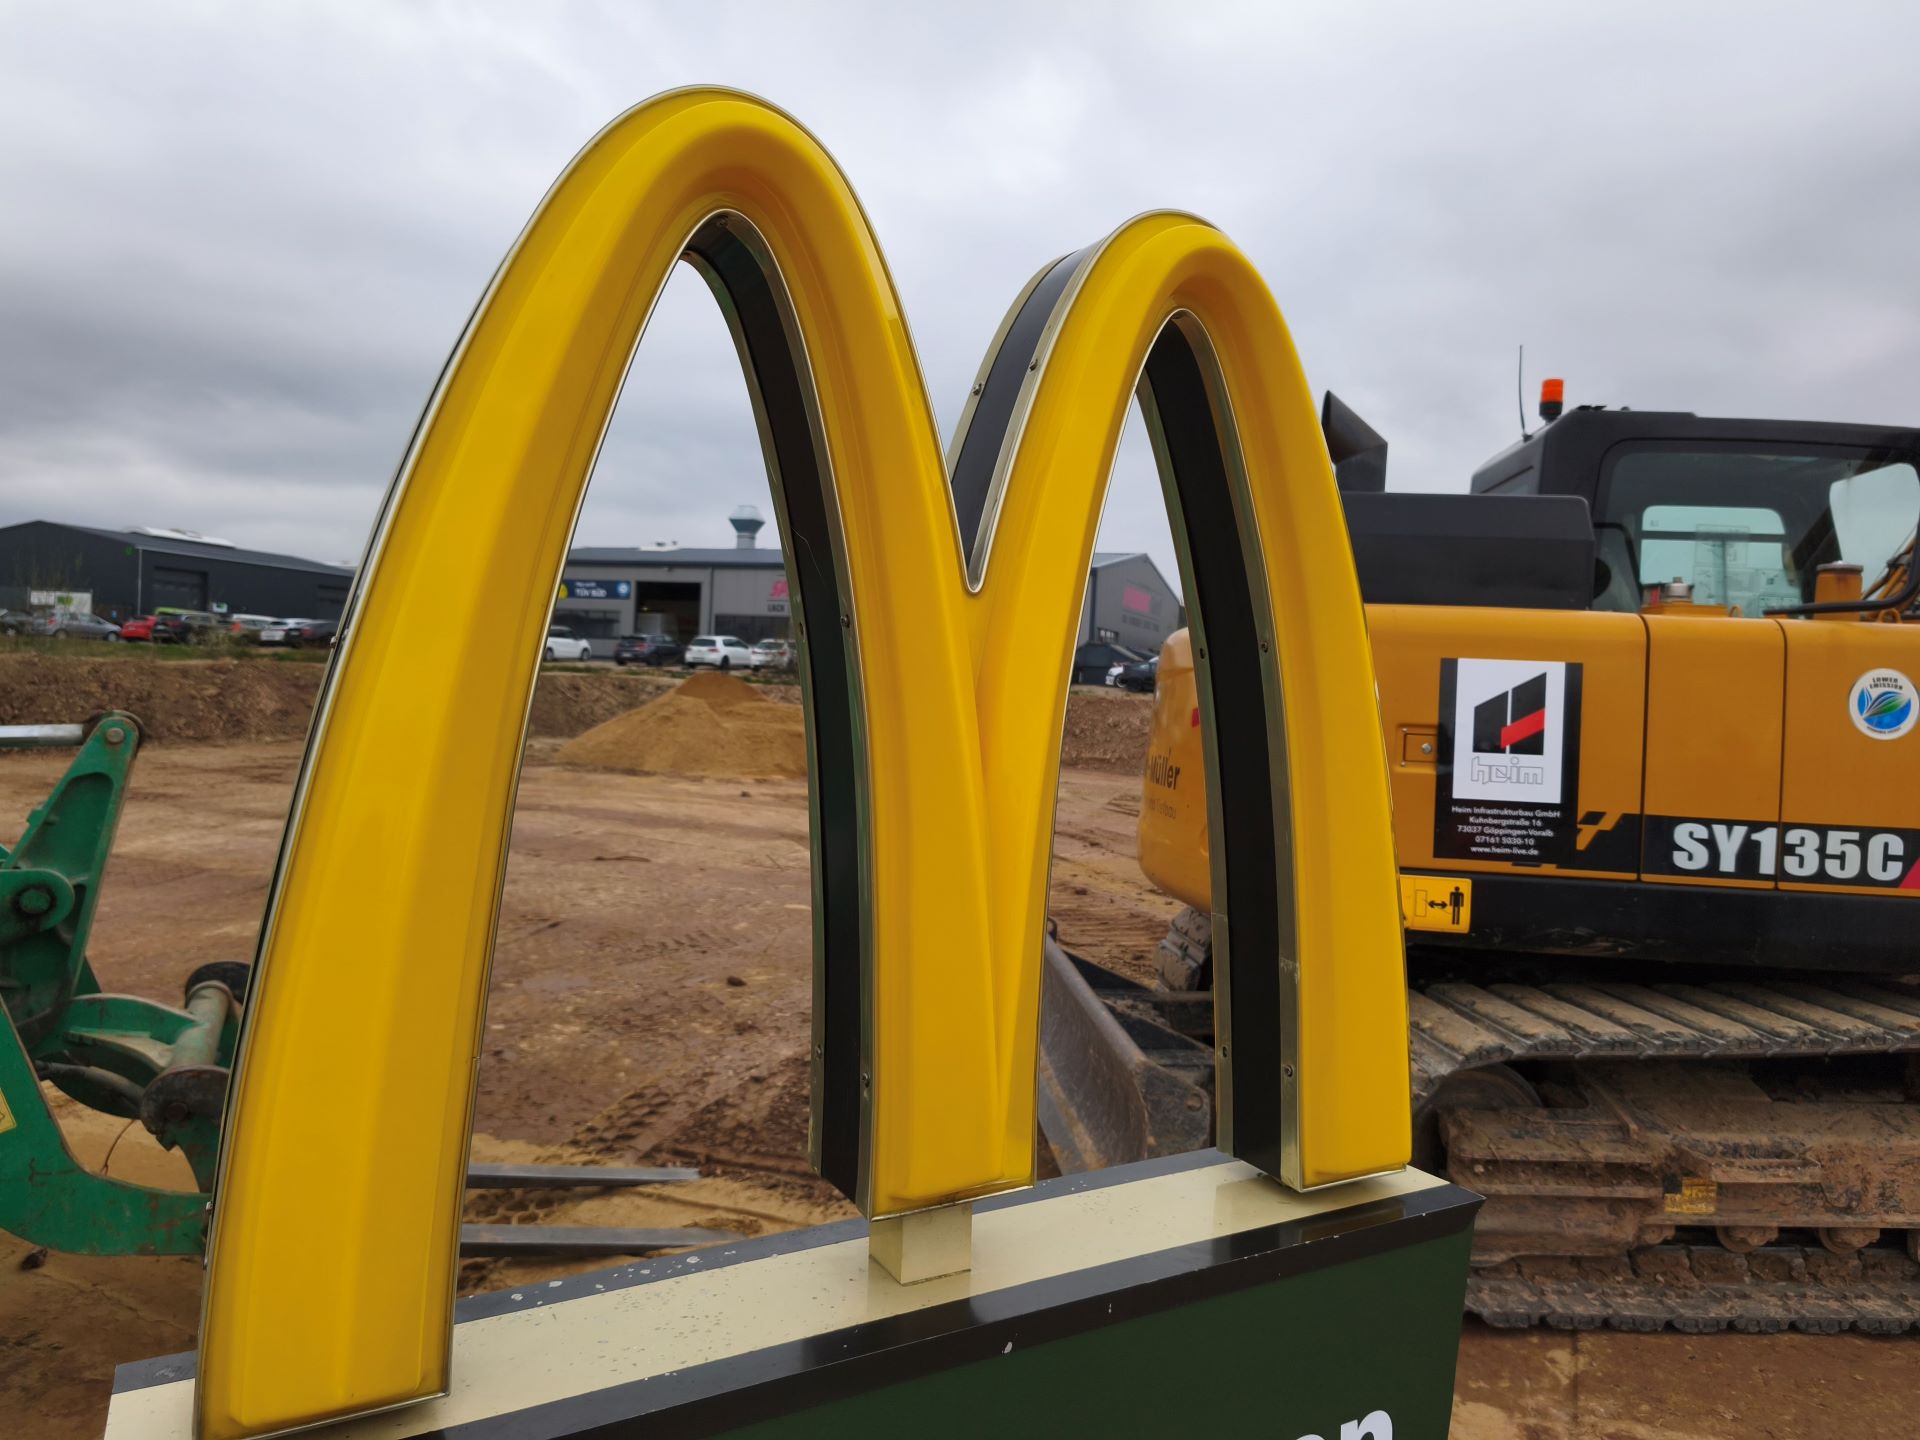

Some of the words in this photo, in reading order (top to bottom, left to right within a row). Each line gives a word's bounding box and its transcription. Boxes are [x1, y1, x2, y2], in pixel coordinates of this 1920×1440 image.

[1471, 756, 1543, 784] heim
[1451, 806, 1472, 814] Heim
[1473, 807, 1534, 817] Infrastrukturbau
[1535, 810, 1561, 818] GmbH
[1532, 819, 1542, 827] 16
[1475, 836, 1500, 844] 07161
[1672, 822, 1904, 881] SY135C
